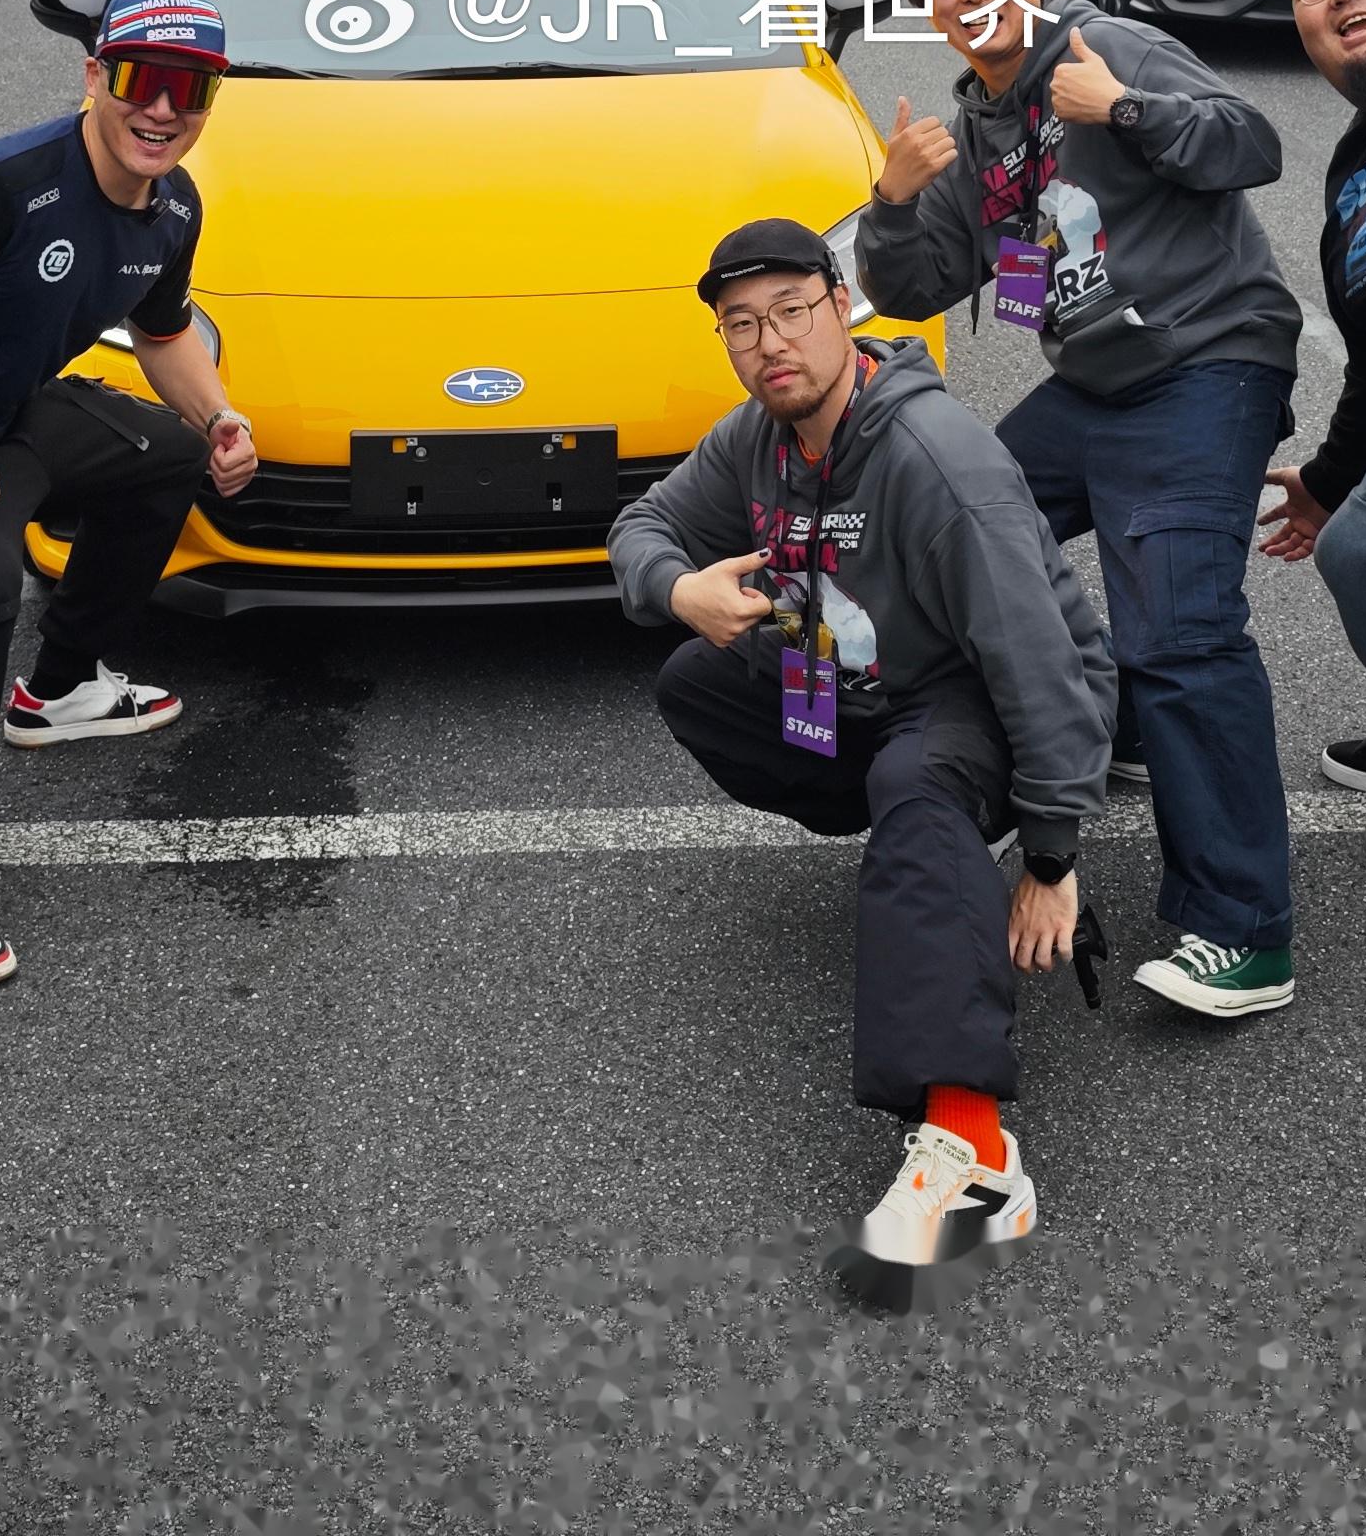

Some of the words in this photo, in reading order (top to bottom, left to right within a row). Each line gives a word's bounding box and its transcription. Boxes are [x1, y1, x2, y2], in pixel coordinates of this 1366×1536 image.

[144, 13, 194, 27] RACING
[146, 27, 196, 41] sparco
[27, 187, 60, 214] sparco
[45, 251, 69, 267] TG
[997, 296, 1042, 319] STAFF
[785, 716, 834, 743] STAFF
